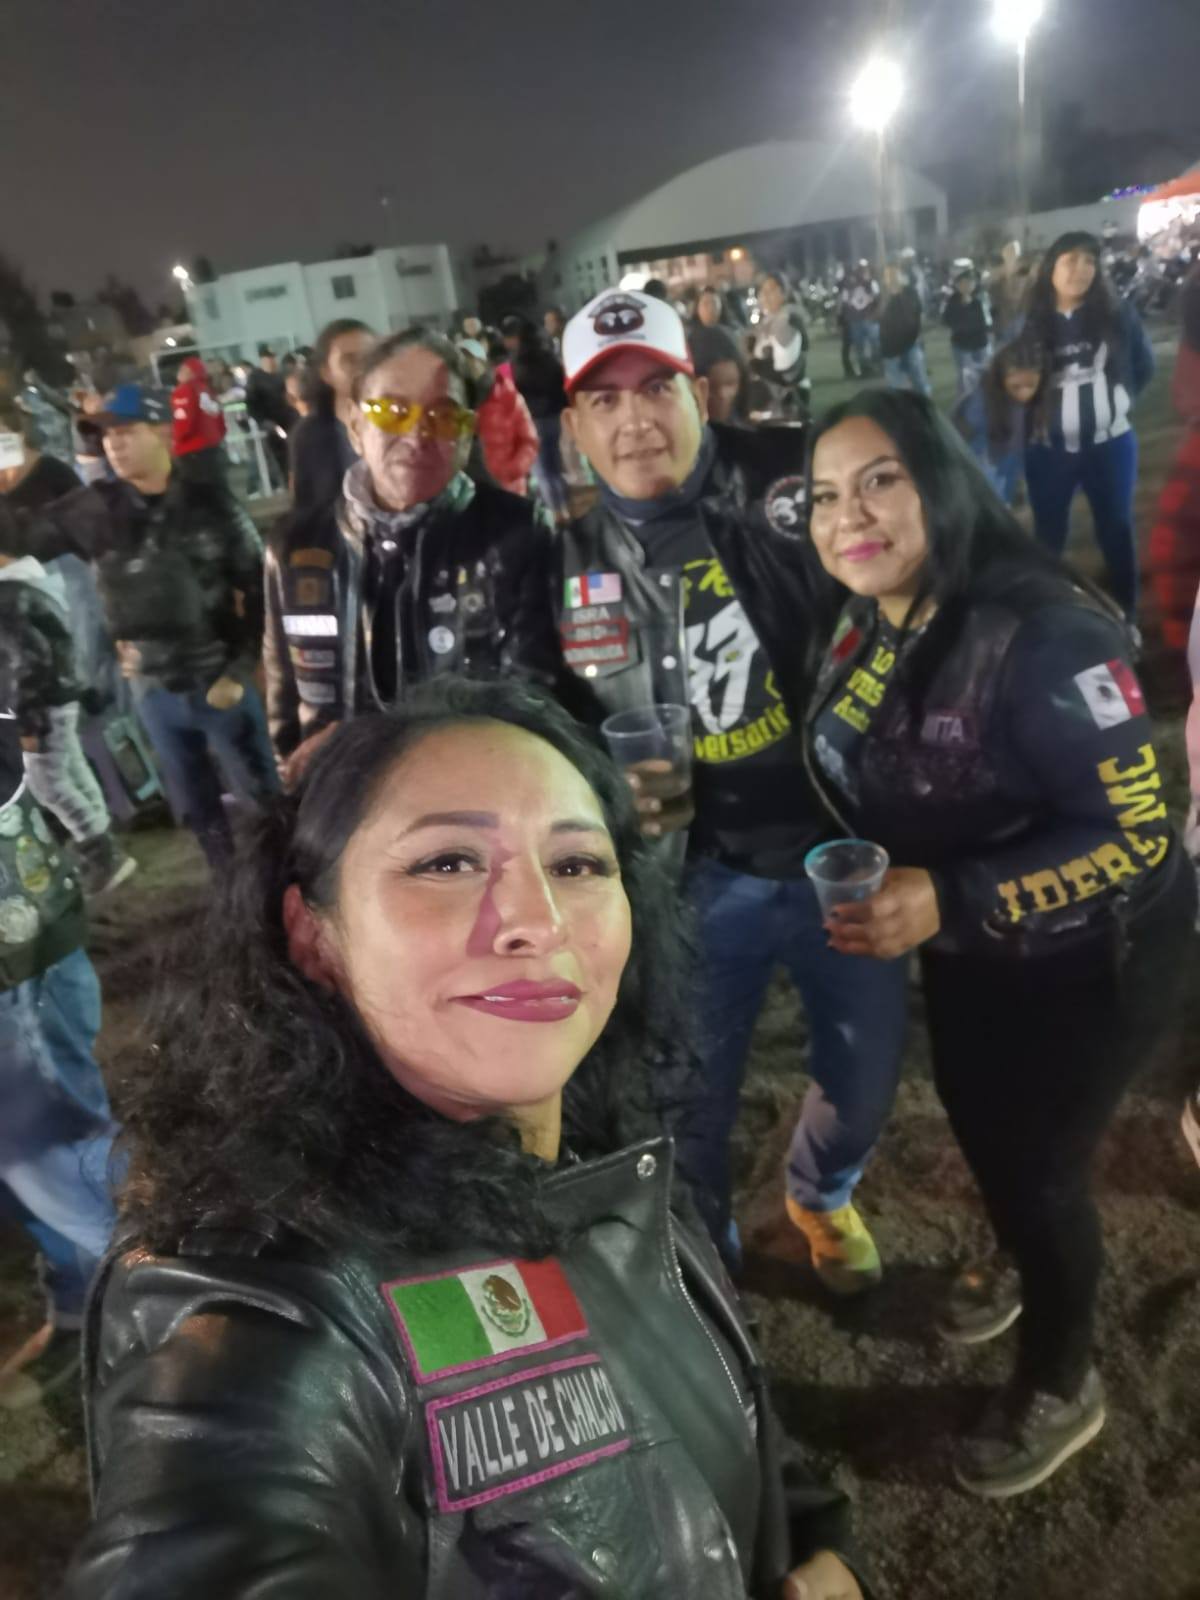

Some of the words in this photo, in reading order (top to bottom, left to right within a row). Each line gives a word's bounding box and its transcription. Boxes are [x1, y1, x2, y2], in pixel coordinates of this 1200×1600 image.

[1098, 744, 1166, 828] MC
[439, 1394, 528, 1490] VALLE
[523, 1385, 565, 1459] DE
[553, 1367, 625, 1446] CHALCO
